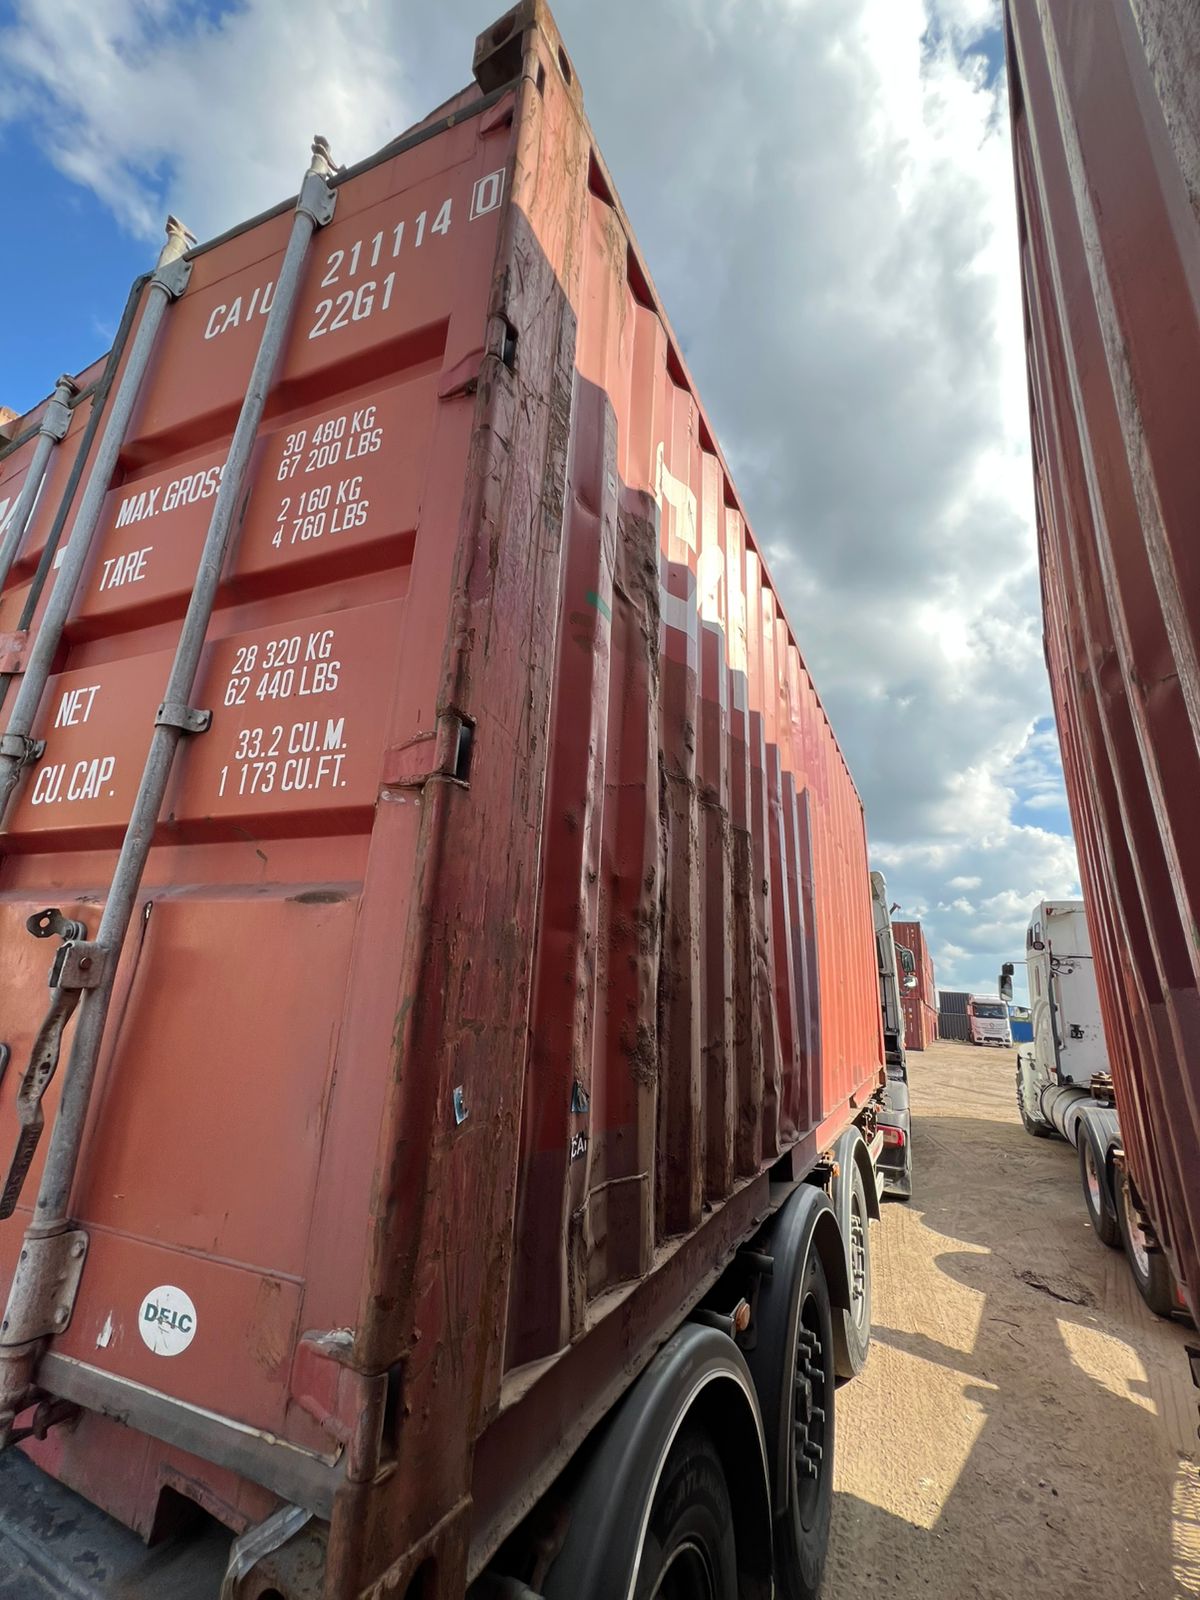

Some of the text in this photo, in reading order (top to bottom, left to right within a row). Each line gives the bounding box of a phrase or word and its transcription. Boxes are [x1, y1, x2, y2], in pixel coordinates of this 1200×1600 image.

[204, 282, 275, 340] CAIU
[321, 198, 453, 288] 211114
[309, 272, 396, 339] 22G1
[277, 428, 383, 481] 67 200 LBS
[283, 431, 306, 456] 30
[312, 416, 346, 446] 480
[351, 406, 377, 433] KG
[99, 476, 363, 591] TARE 2 160 KG
[272, 501, 369, 548] 4 760 LBS
[54, 630, 334, 728] NET 28 320 KG
[224, 661, 340, 706] 62 440 LBS
[31, 718, 348, 805] CU.CAP. 33.2 CU.M.
[218, 754, 347, 796] 1 173 CU.FT.
